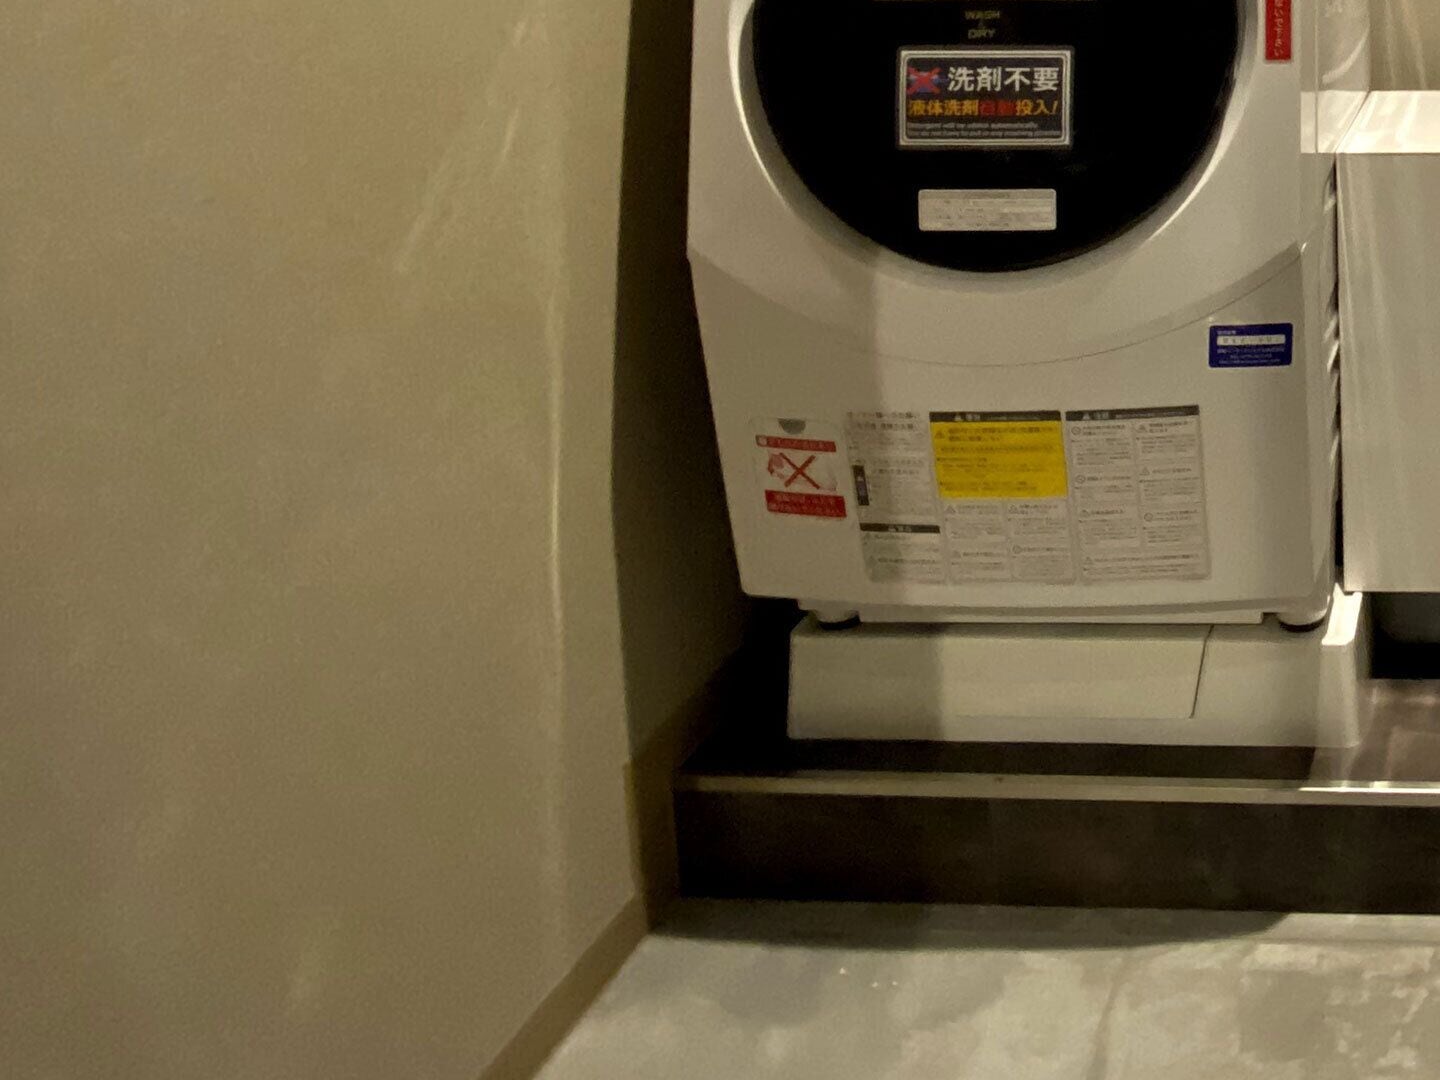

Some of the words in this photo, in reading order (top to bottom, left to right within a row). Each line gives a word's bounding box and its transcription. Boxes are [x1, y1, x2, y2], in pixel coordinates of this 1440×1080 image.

[965, 10, 999, 19] WASH
[968, 29, 996, 39] DRY
[947, 66, 1060, 92] 洗剤不要
